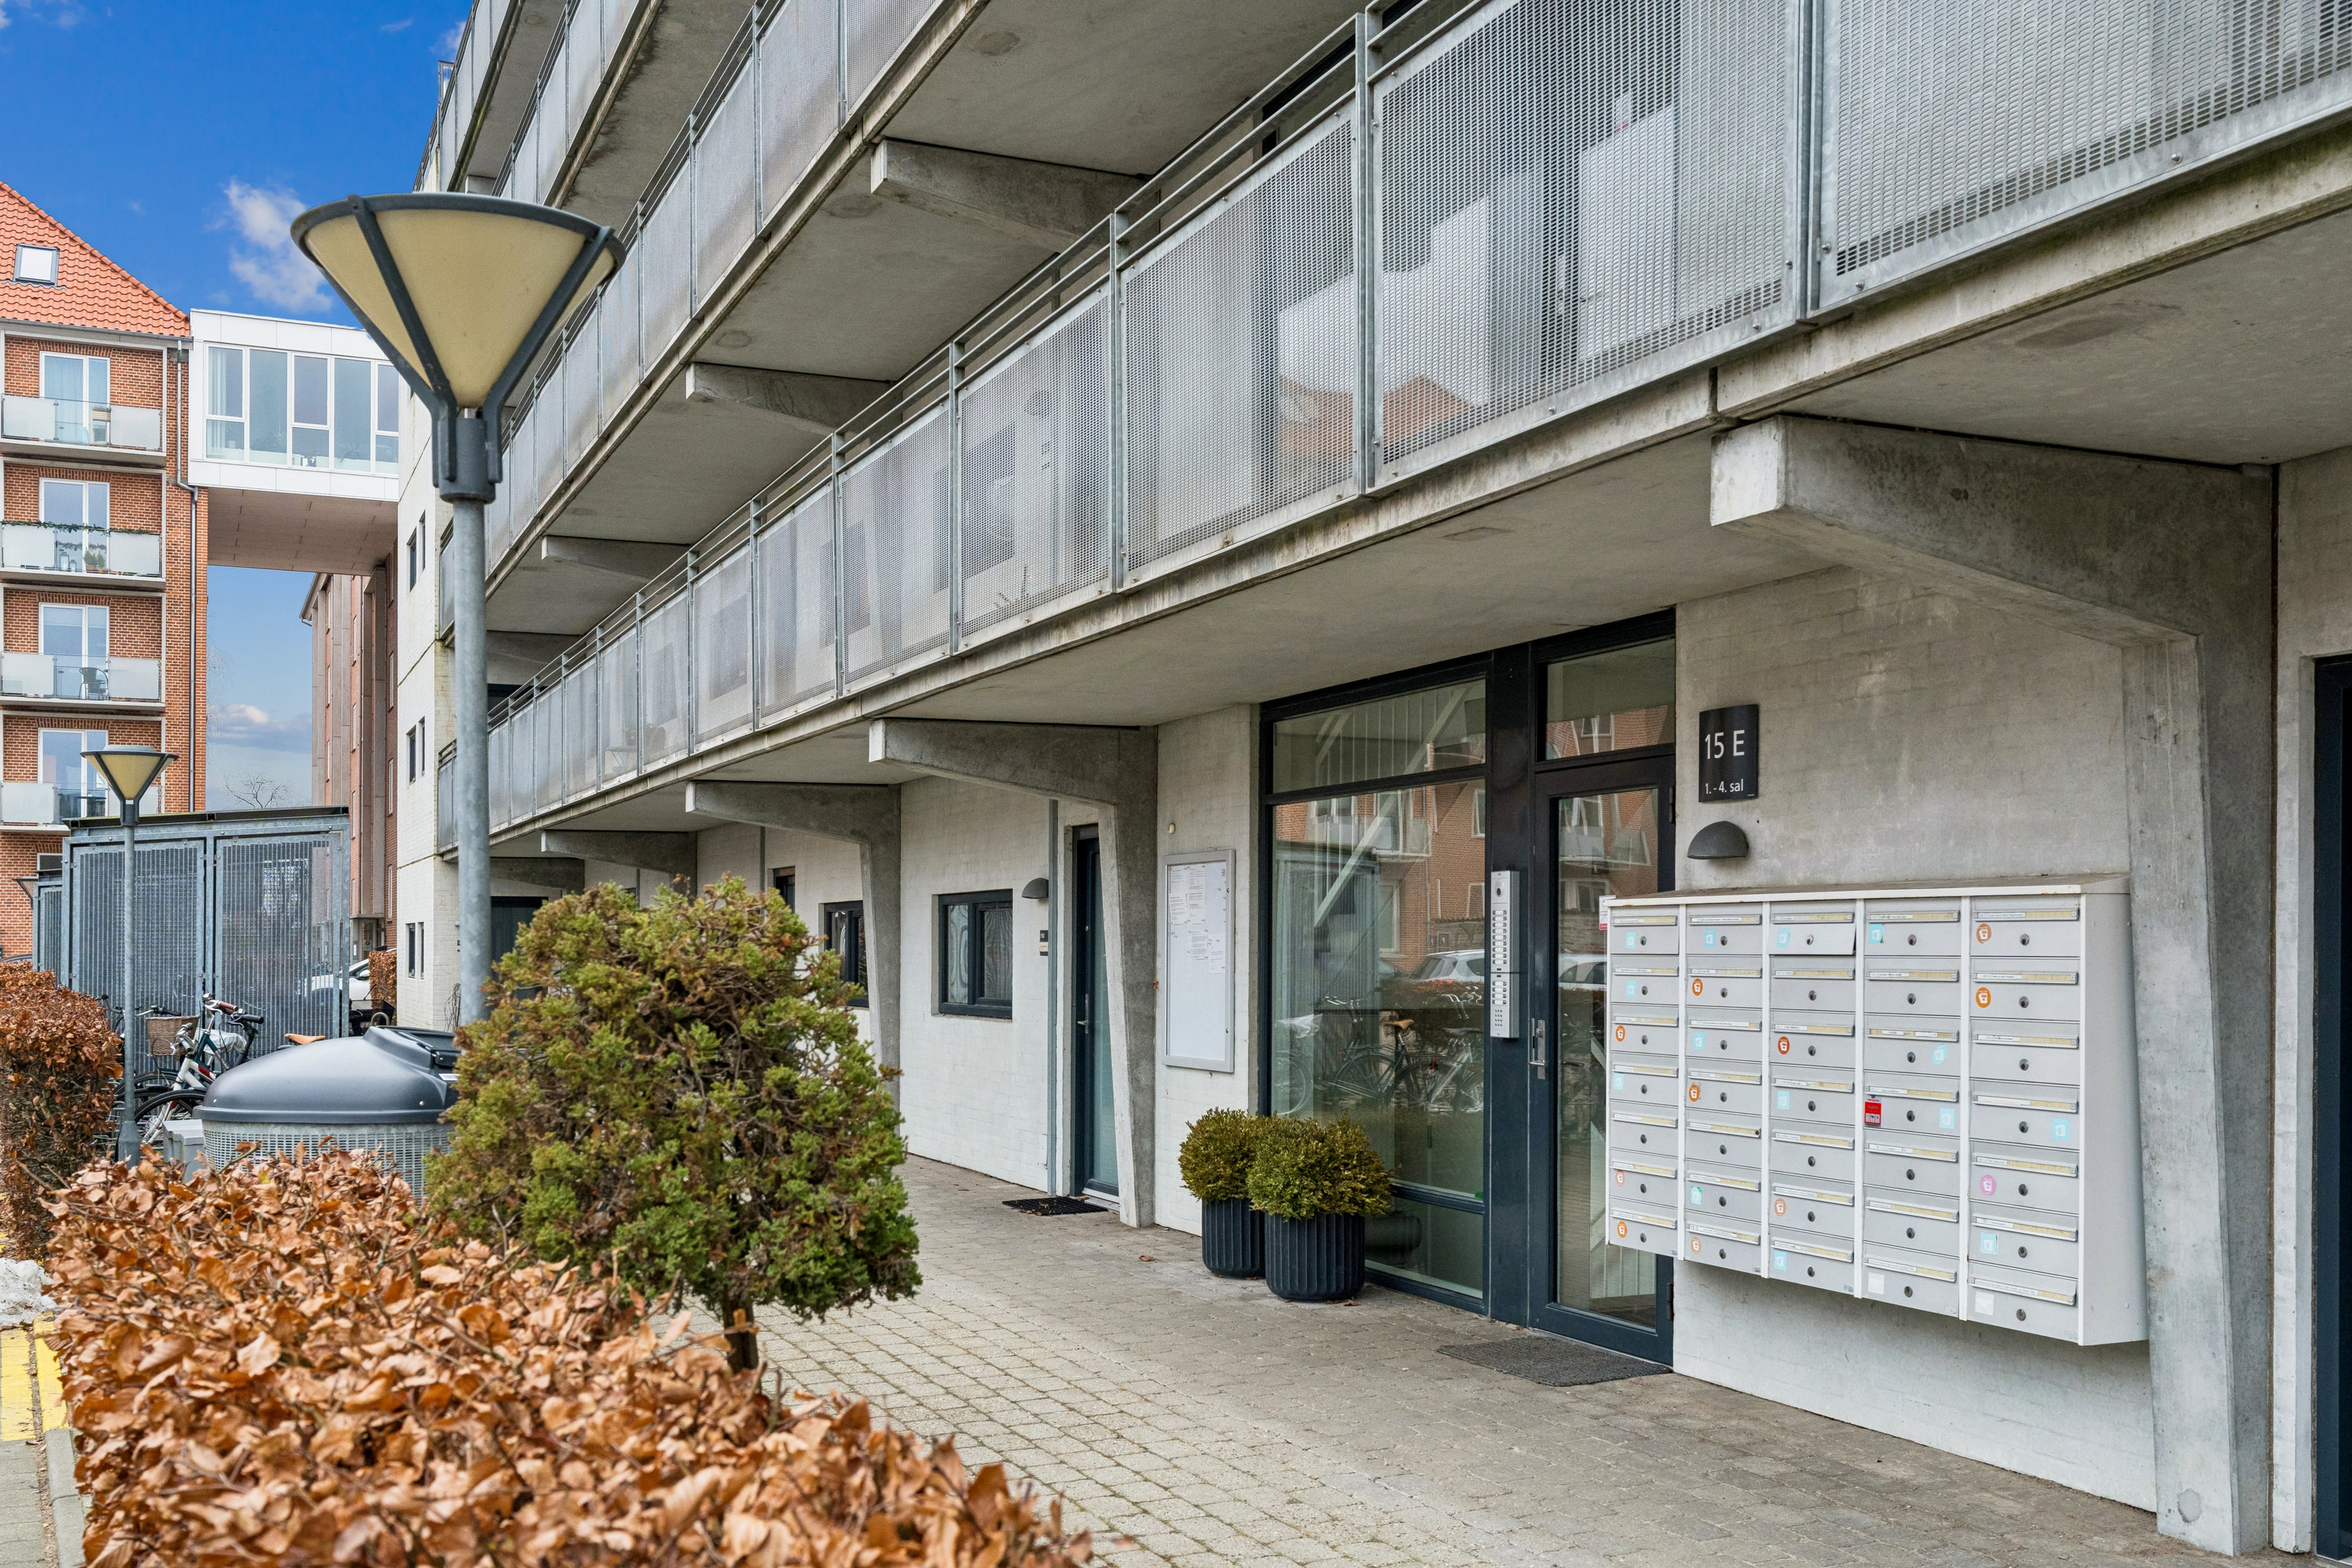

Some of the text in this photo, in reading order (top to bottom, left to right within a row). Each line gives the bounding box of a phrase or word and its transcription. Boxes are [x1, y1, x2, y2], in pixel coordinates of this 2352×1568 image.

[1704, 729, 1745, 760] 15 E
[1730, 779, 1744, 793] sal
